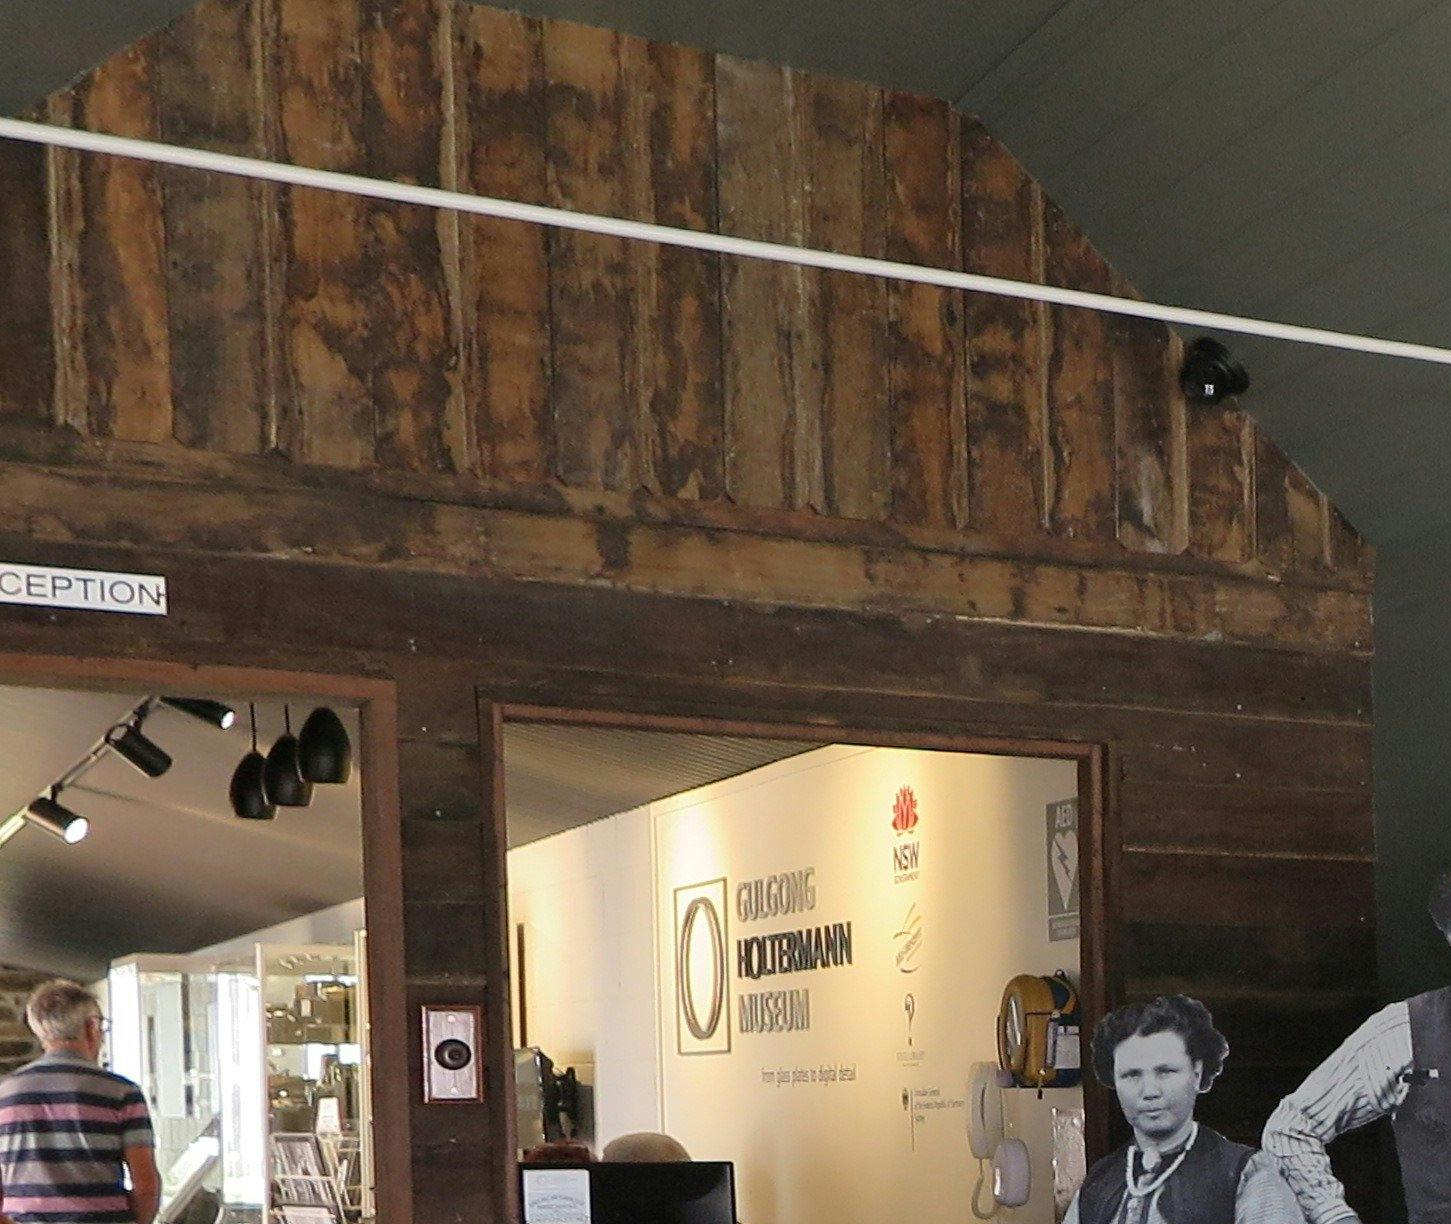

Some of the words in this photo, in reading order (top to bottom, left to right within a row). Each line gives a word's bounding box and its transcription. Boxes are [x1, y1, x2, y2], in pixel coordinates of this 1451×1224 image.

[0, 571, 161, 605] CEPTION
[893, 841, 919, 873] NSW
[736, 866, 815, 922] GULGONG
[737, 921, 853, 979] HOLTERMANN
[738, 988, 810, 1034] MUSEUM
